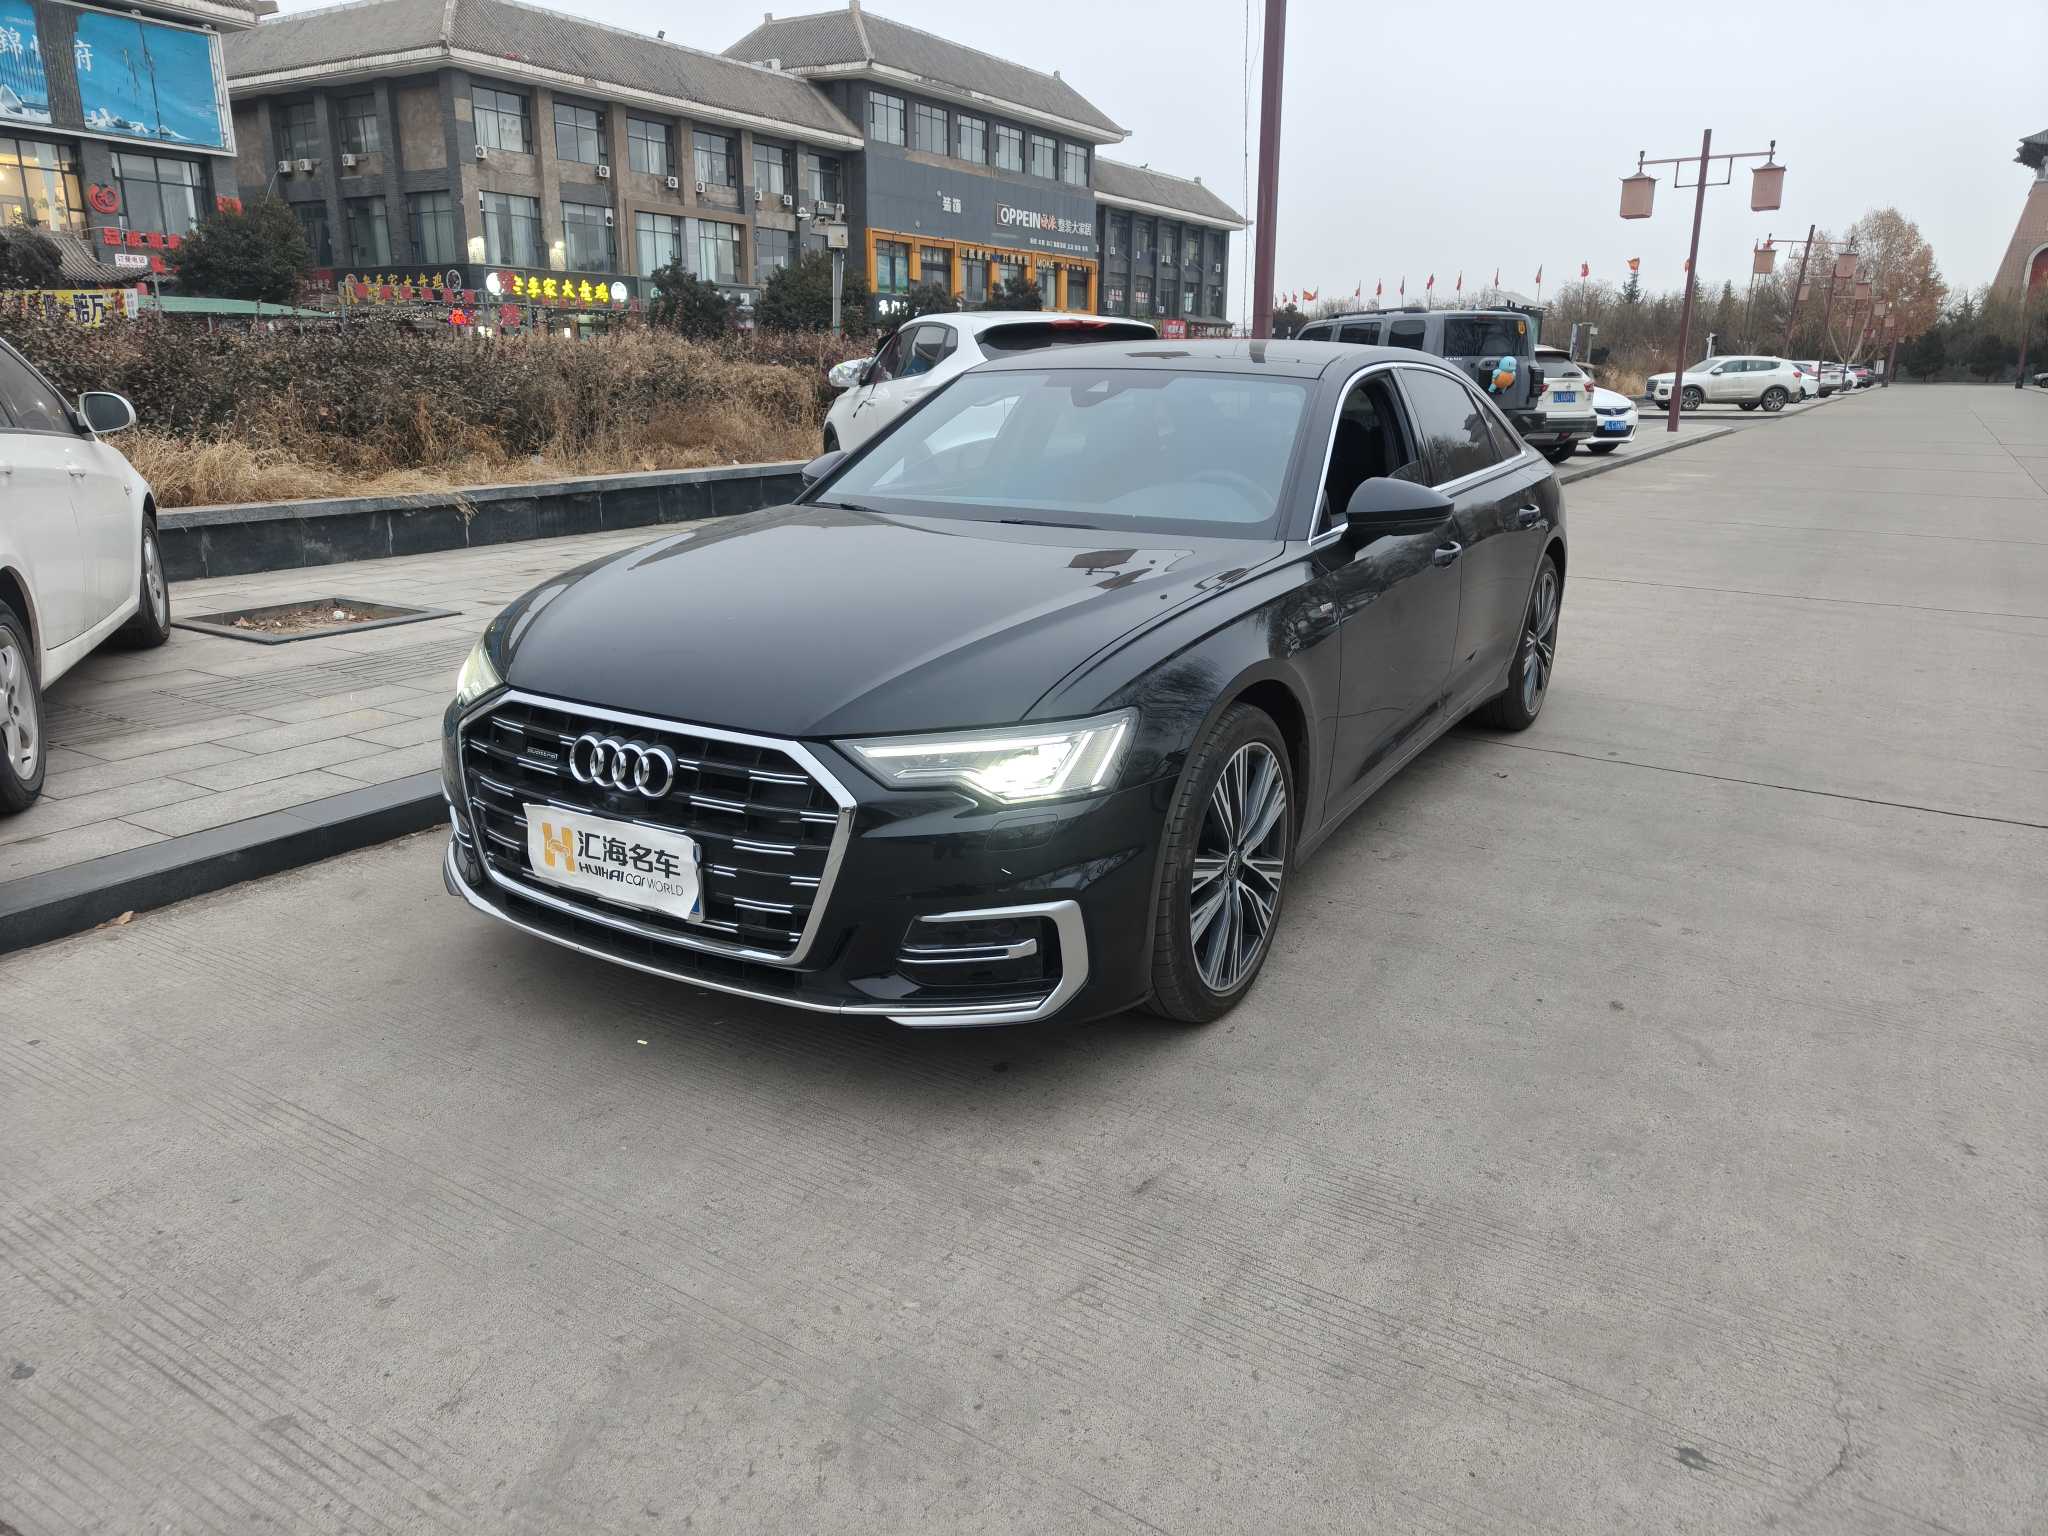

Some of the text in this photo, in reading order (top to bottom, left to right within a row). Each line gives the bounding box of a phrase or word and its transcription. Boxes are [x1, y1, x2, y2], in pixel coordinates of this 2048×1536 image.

[1000, 207, 1041, 229] OPPEIN
[577, 830, 681, 879] 汇海名车
